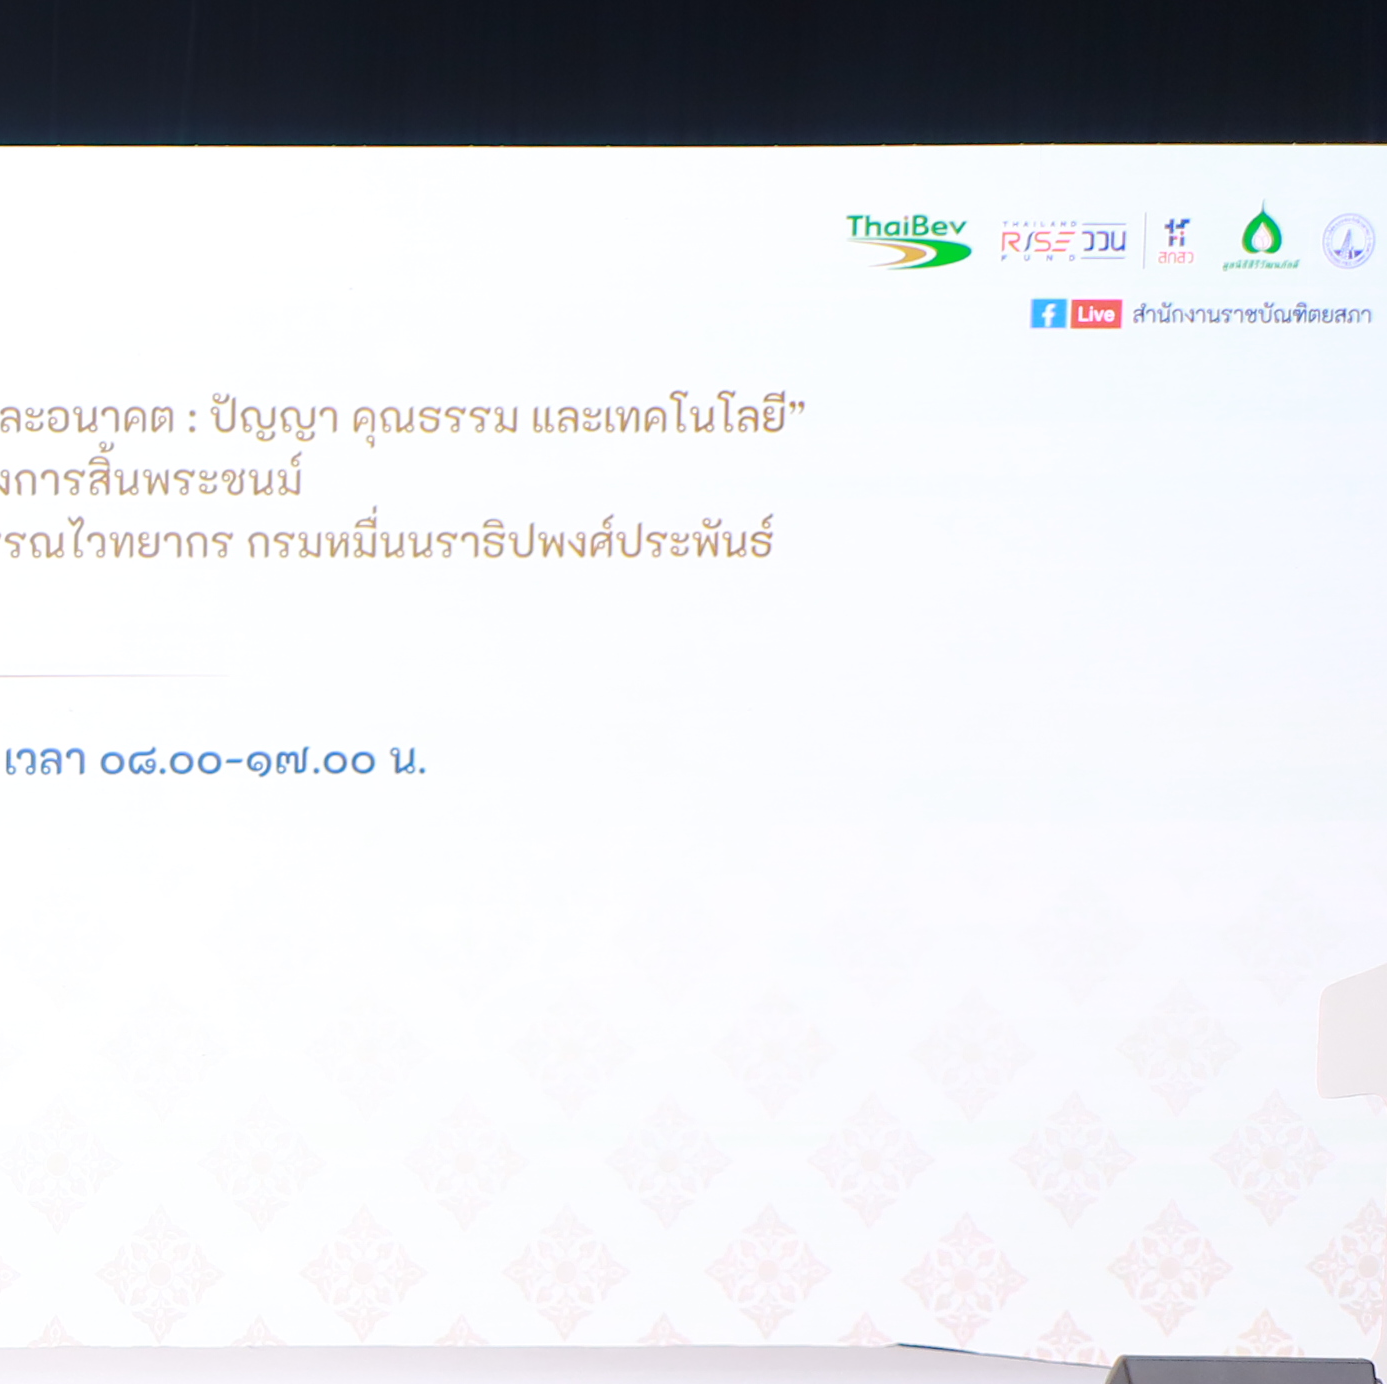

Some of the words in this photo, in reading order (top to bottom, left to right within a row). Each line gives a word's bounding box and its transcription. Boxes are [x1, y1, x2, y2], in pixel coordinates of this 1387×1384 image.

[845, 214, 967, 237] ThaiBev
[1002, 220, 1077, 228] THAILAND
[1000, 231, 1076, 253] RISE
[1000, 253, 1076, 262] FUND
[1157, 251, 1195, 264] สกสว
[1077, 304, 1116, 323] Live
[1132, 301, 1373, 325] สำนักงานราชบัณฑิตยสภา
[187, 409, 197, 434] :
[209, 391, 339, 444] ปัญญา
[352, 405, 519, 448] คุณธรรม
[531, 389, 806, 435] และเทคโนโลยี”
[246, 505, 775, 560] กรมหมื่นนราธิปพงศ์ประพันธ์
[5, 746, 87, 776] เวลา
[99, 745, 378, 779] ๐๘.๐๐-๑๗.๐๐
[388, 746, 428, 776] น.
